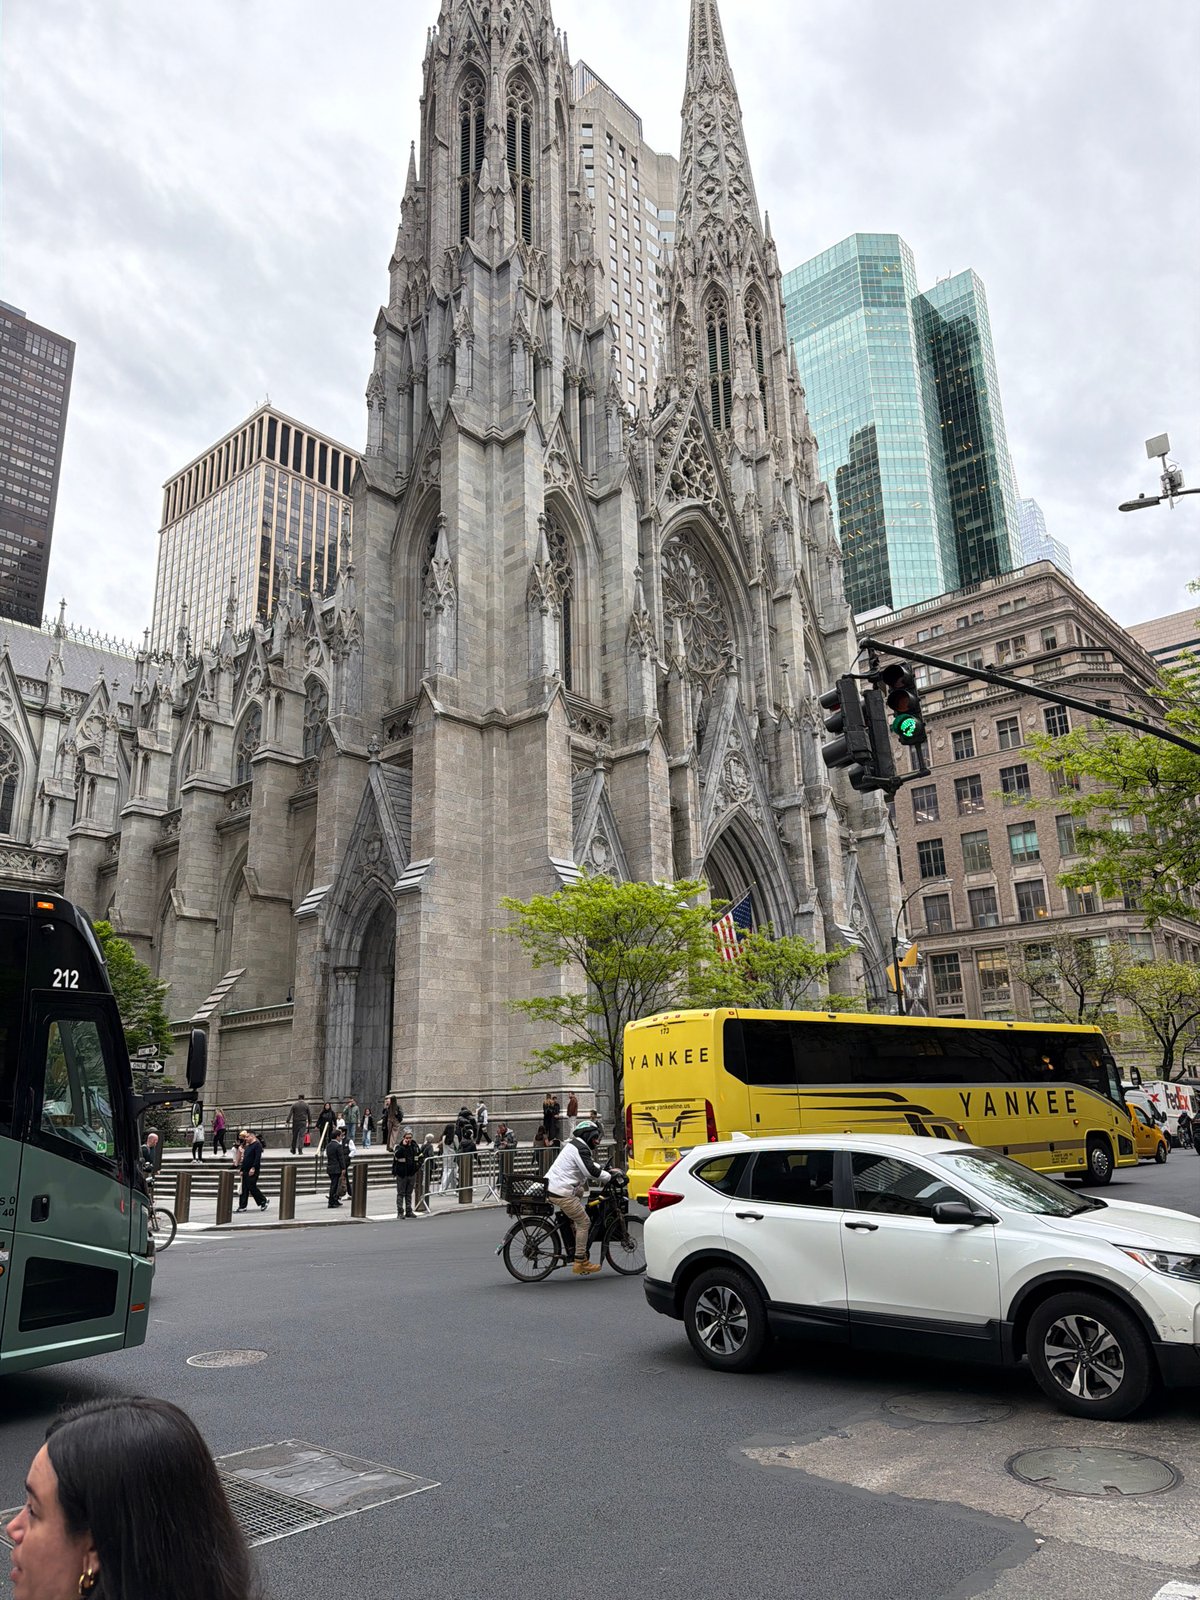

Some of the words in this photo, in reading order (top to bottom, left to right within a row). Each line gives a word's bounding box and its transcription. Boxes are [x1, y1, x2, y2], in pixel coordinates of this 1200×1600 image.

[52, 968, 79, 989] 212
[660, 1027, 669, 1035] 173
[629, 1047, 709, 1070] YANKEE
[644, 1103, 691, 1111] www.yankeeline.us
[959, 1090, 1077, 1117] YANKEE
[1164, 1084, 1190, 1111] FedEx
[2, 1208, 15, 1217] 40
